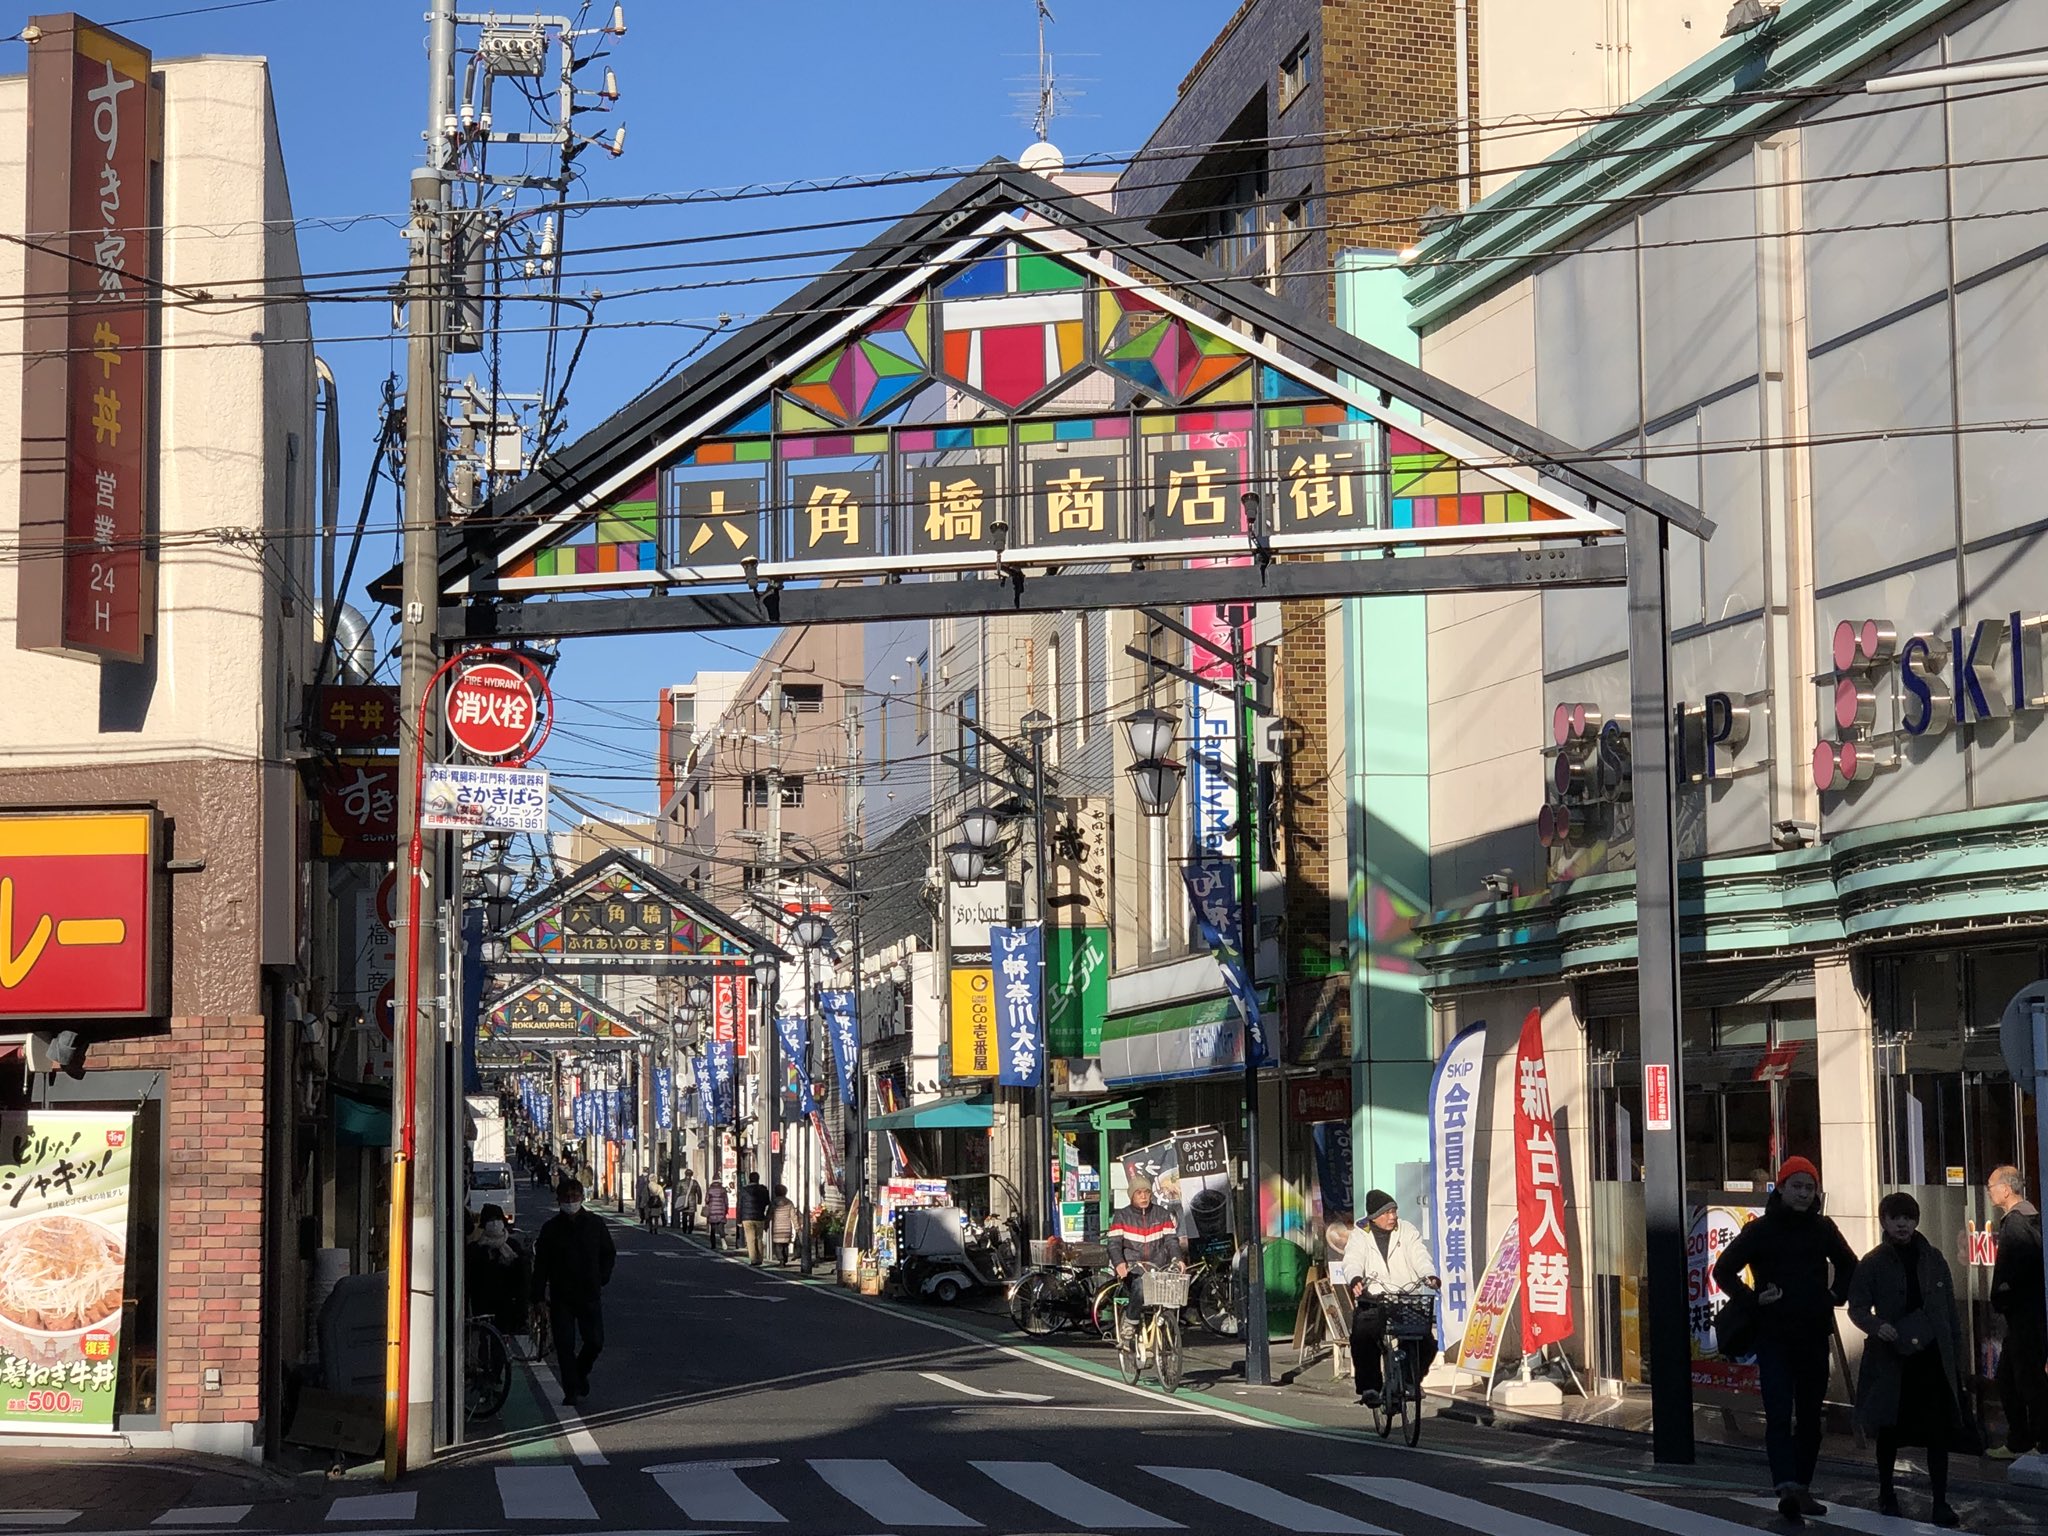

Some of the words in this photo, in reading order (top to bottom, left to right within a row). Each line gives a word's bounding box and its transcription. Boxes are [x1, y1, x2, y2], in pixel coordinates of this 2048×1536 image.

[88, 60, 134, 302] すき家
[92, 320, 122, 448] 牛丼
[689, 452, 1353, 555] 六角橋商店街
[463, 676, 482, 686] FIRE
[484, 677, 521, 690] HYDRANT
[330, 701, 384, 730] 牛丼
[454, 690, 528, 730] 消火栓
[457, 785, 543, 807] さかきばら
[487, 805, 543, 817] クリニック
[495, 817, 544, 829] 435-1961
[571, 903, 662, 926] 六角橋
[568, 938, 665, 951] ふれあいのまち
[514, 1001, 573, 1015] 六角橋
[512, 1020, 575, 1031] ROKKAKUBASHI
[1519, 1056, 1570, 1316] 新台入替
[1443, 1082, 1471, 1322] 会員募集中
[85, 1340, 111, 1356] 復活
[0, 1358, 116, 1391] 髪ねぎ牛丼
